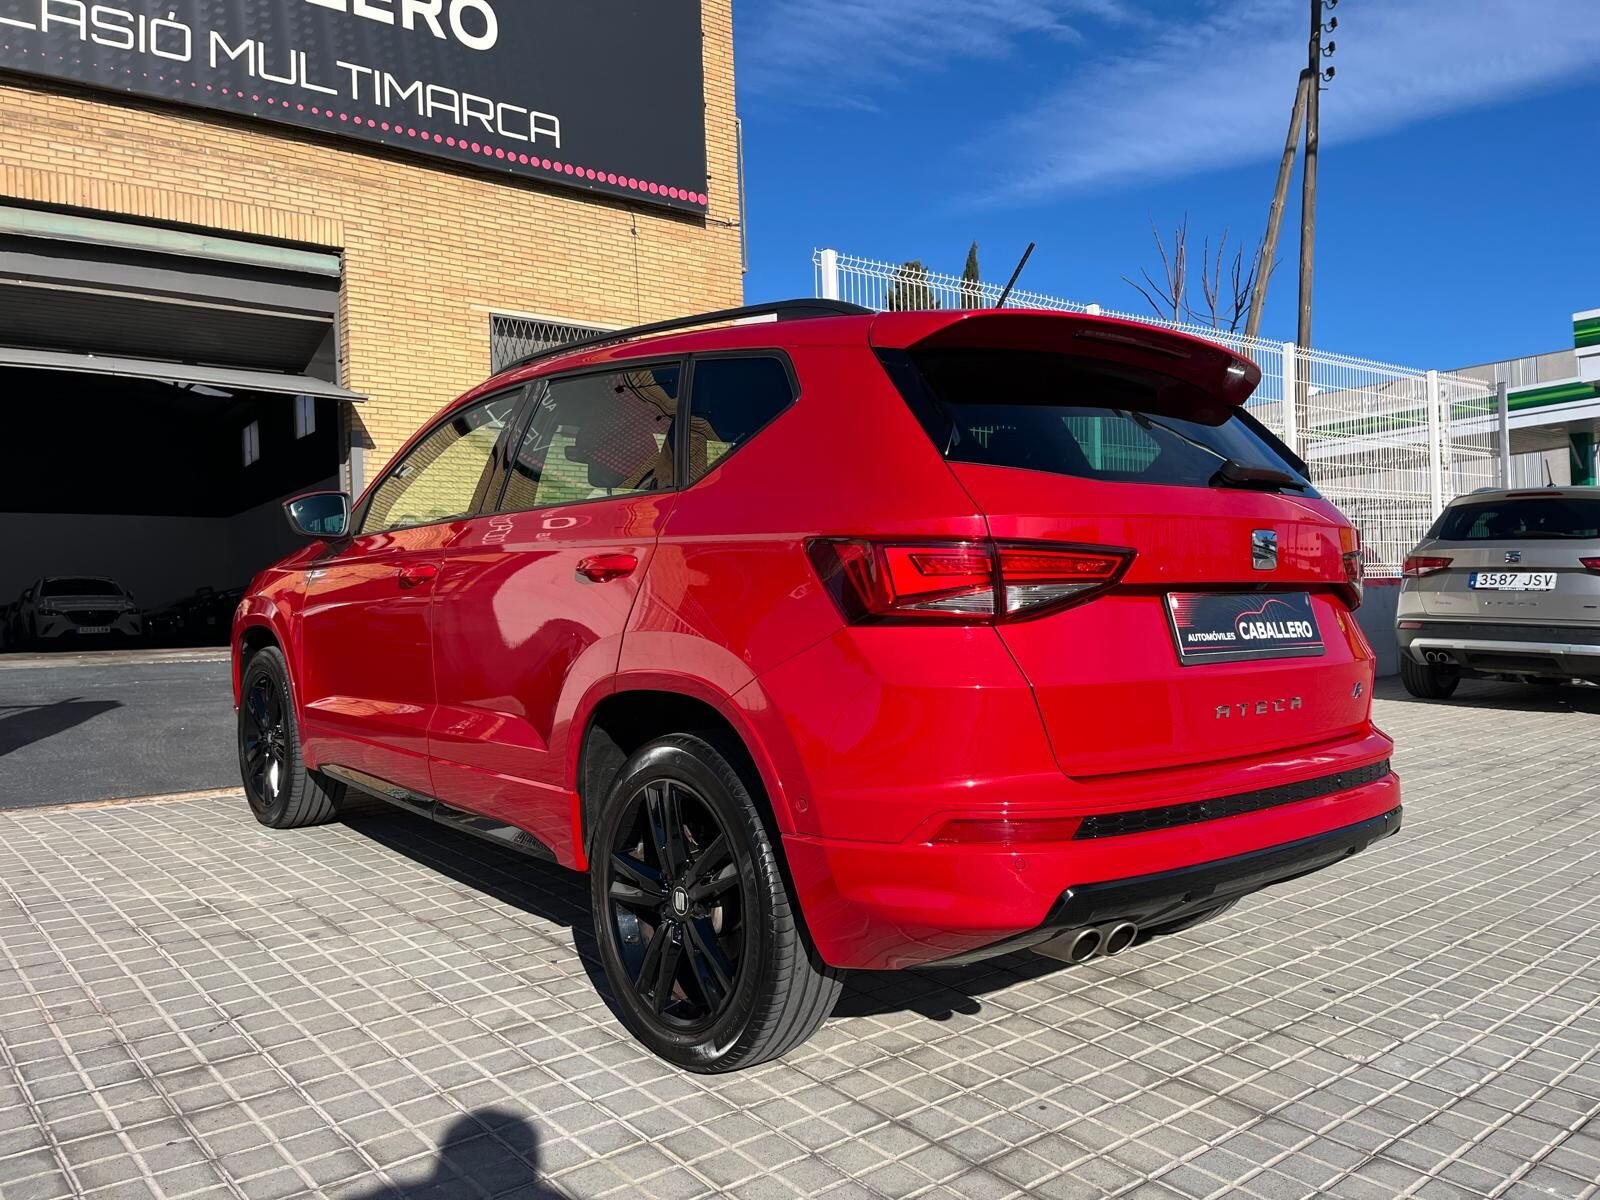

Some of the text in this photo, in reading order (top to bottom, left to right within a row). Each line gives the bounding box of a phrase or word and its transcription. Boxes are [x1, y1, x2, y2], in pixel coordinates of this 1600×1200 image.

[0, 0, 561, 149] ASIÓ MULTIMARCA
[1480, 574, 1553, 587] 3587 JSV
[1187, 620, 1313, 642] AUTOMÓVILES CABALLERO
[1215, 697, 1302, 719] ATECA
